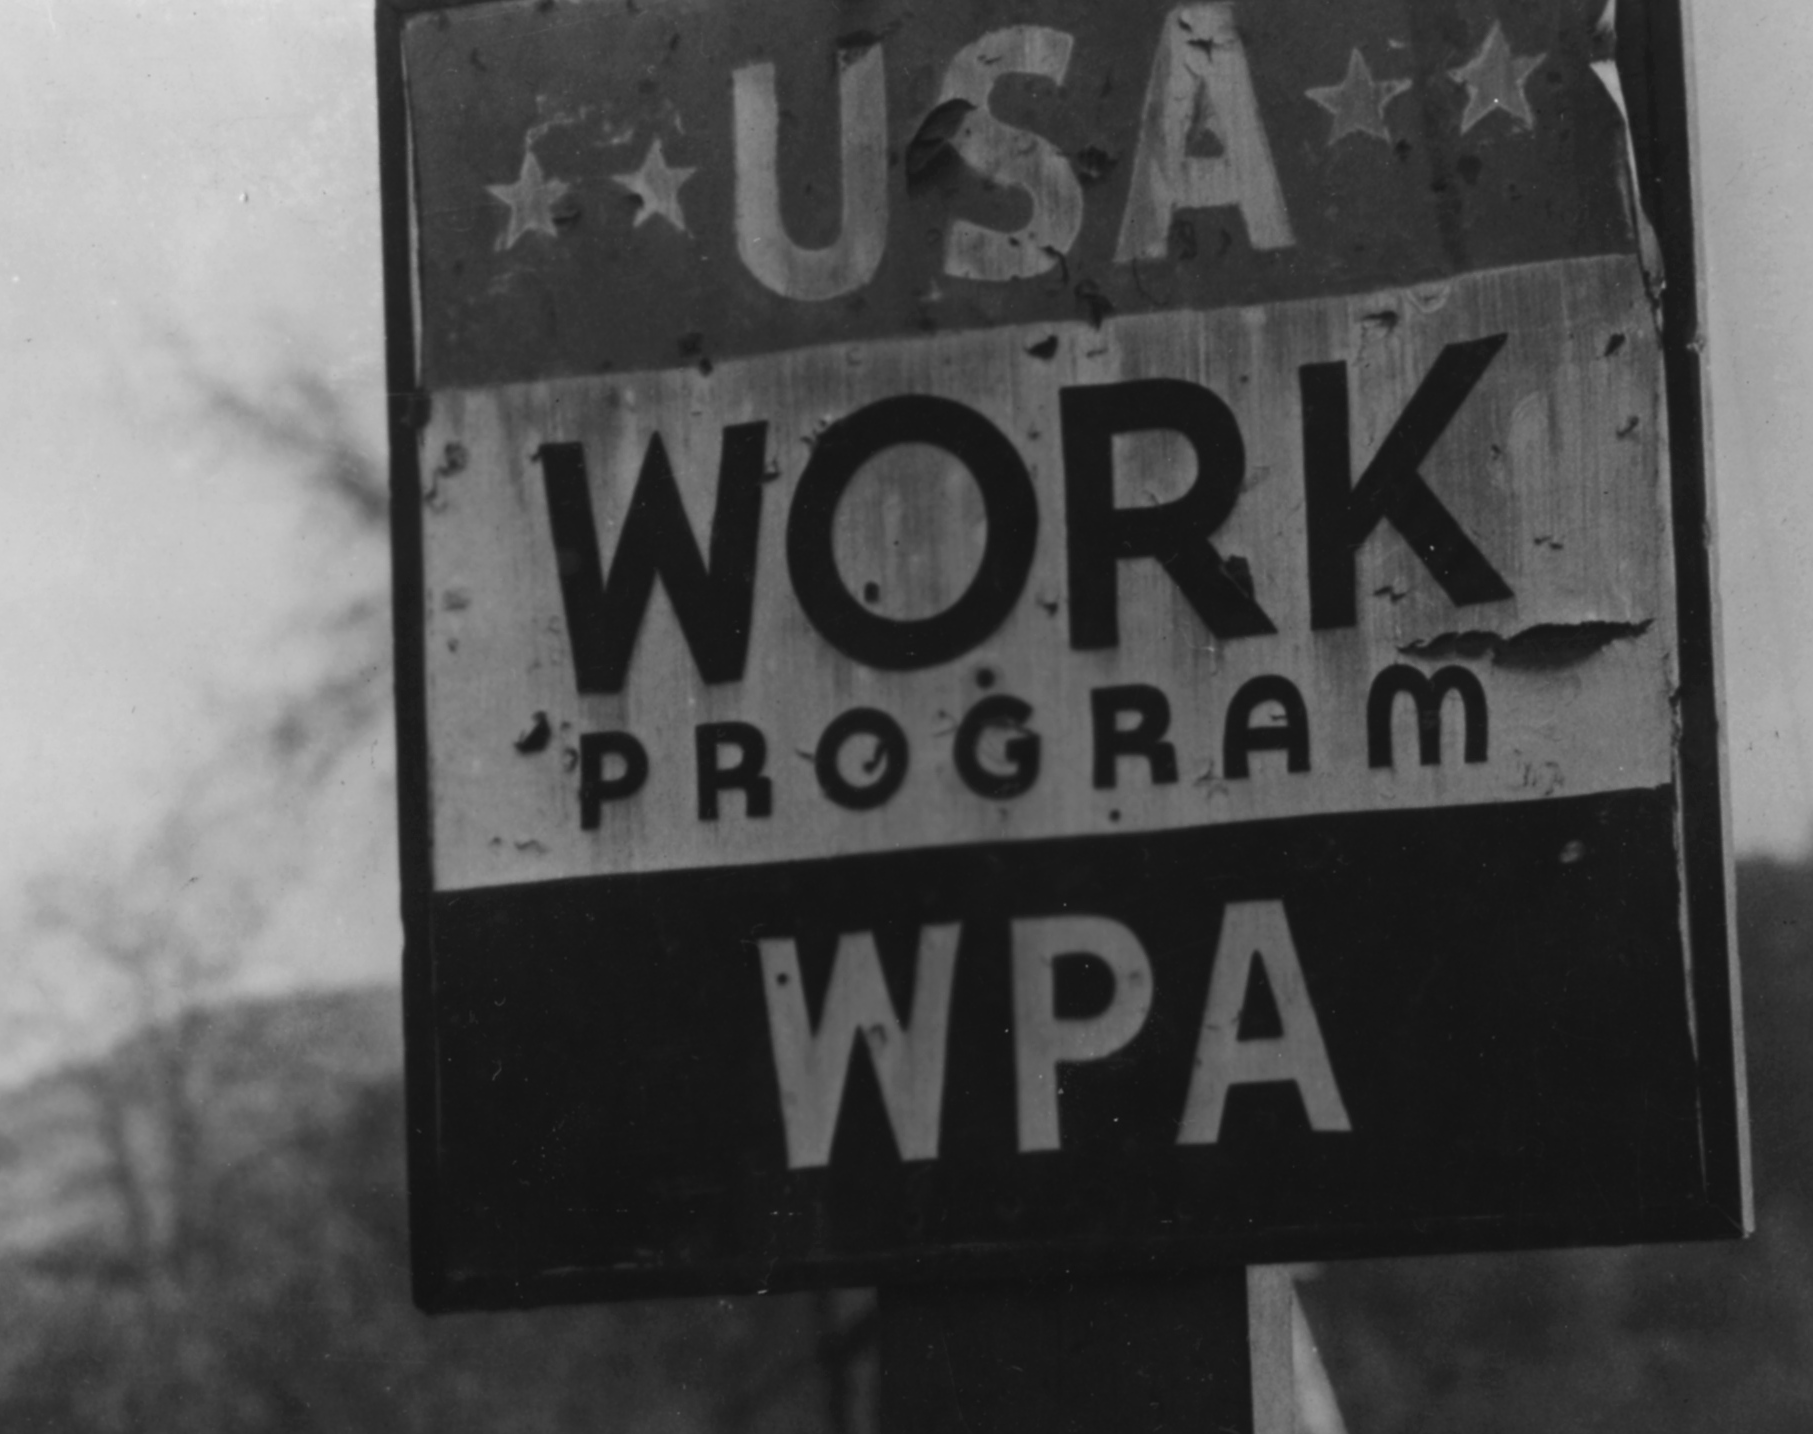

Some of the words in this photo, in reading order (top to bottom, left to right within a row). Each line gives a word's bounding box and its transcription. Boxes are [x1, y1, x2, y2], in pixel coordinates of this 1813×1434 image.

[732, 1, 1297, 303] USA
[540, 332, 1516, 694] WORK
[576, 662, 1490, 830] PROGRAM
[757, 899, 1352, 1170] WPA
